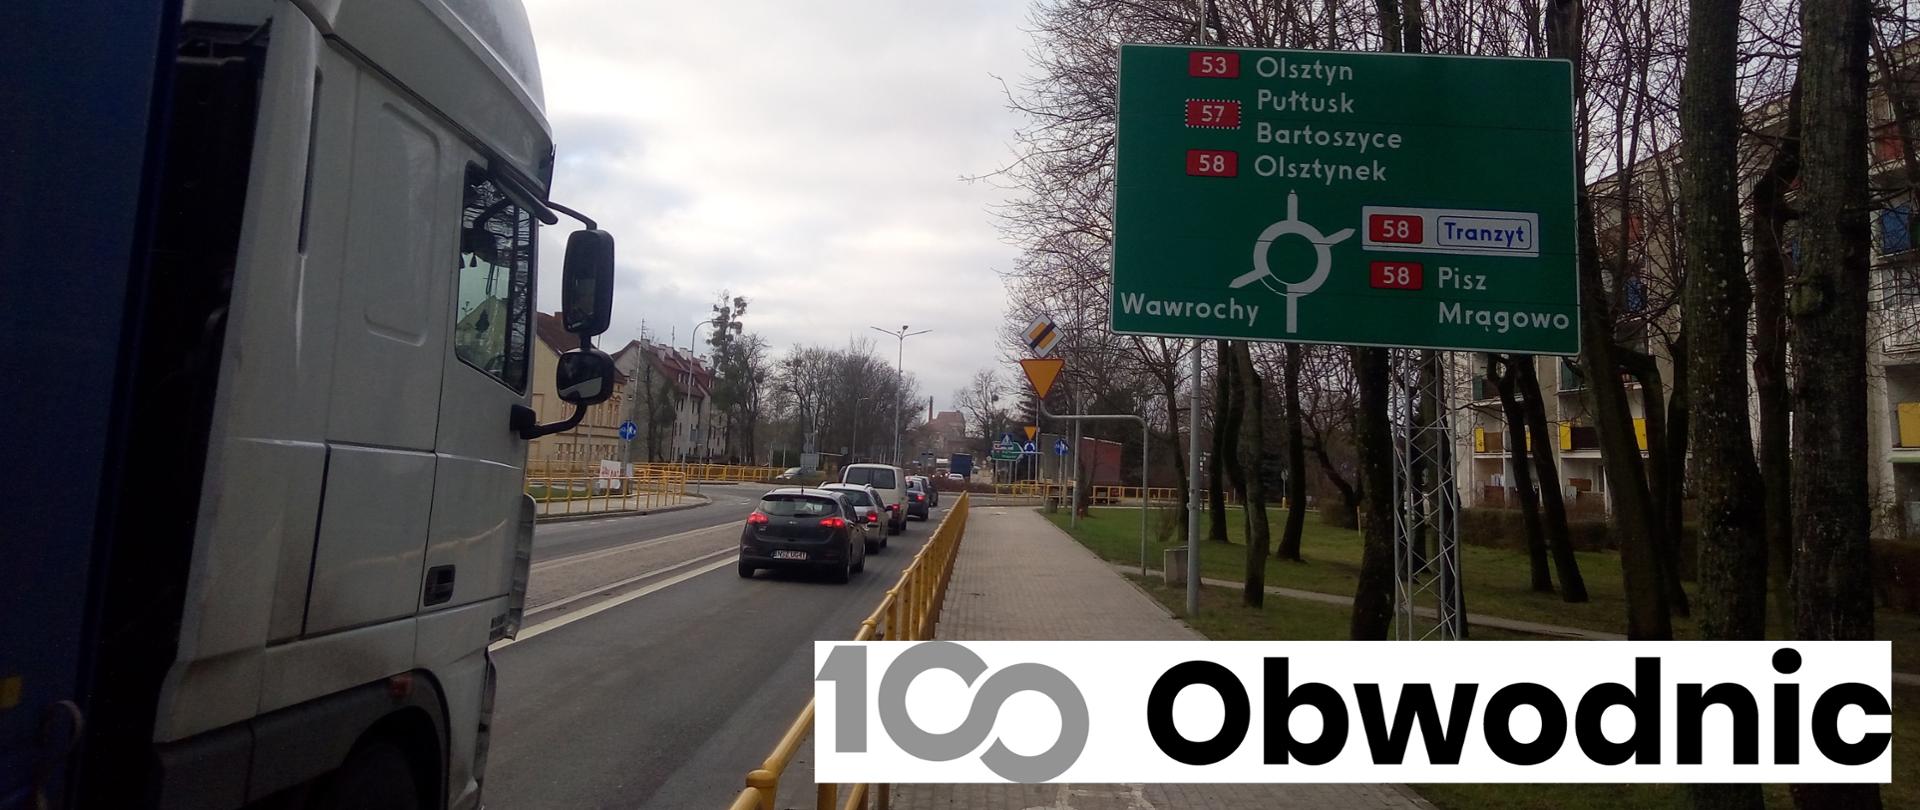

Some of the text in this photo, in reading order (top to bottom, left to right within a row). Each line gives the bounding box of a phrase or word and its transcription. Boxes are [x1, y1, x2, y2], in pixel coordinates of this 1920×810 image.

[1201, 56, 1354, 86] 53 Olsztyn
[1201, 106, 1225, 123] 57
[1257, 89, 1354, 114] Pułtusk
[1256, 122, 1402, 154] Bartoszyce
[1198, 154, 1387, 186] 58 Olsztynek
[1382, 220, 1525, 248] 58 Tranzyt
[1383, 266, 1487, 290] 58 Pisz
[1121, 292, 1259, 326] Wawrochy
[1439, 302, 1570, 333] Mrągowo
